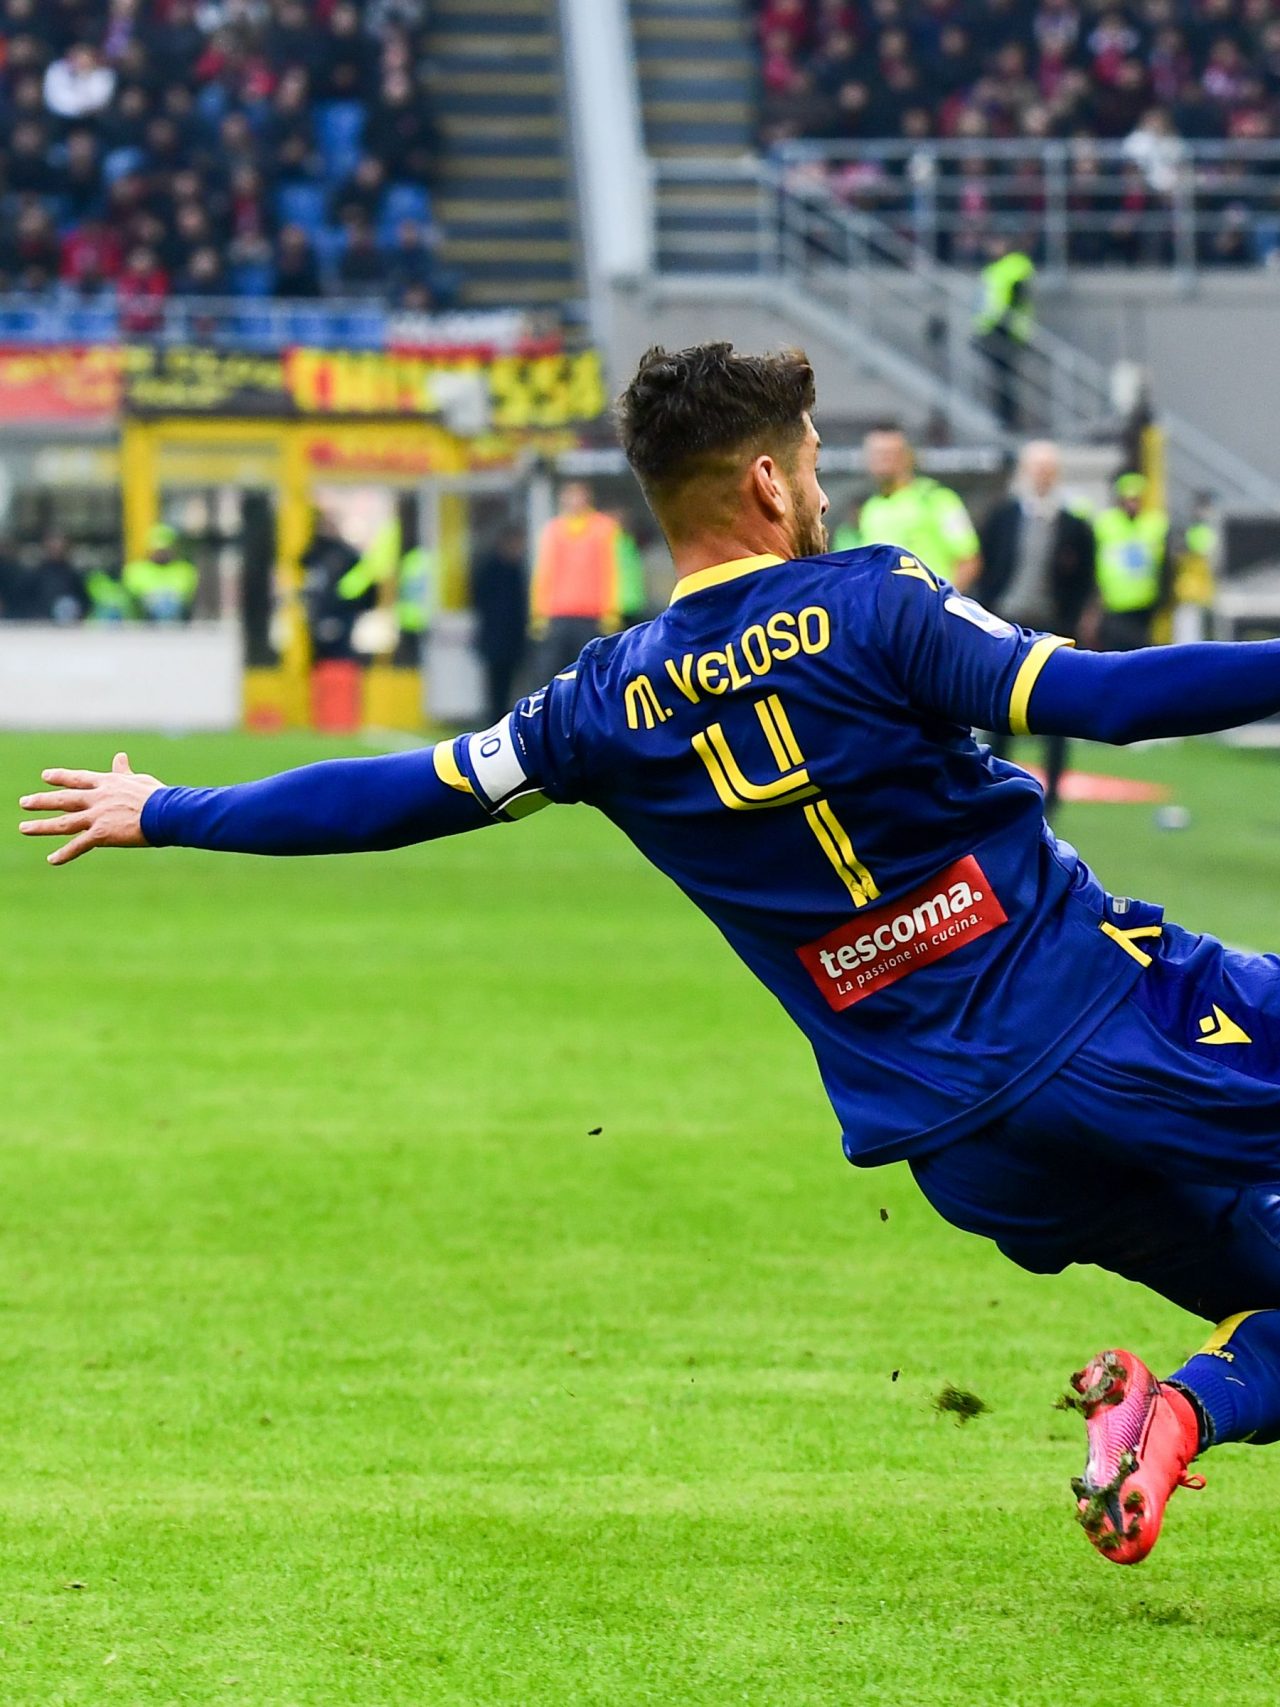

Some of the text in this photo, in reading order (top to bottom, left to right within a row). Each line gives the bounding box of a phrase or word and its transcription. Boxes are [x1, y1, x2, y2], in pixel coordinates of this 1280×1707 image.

[624, 674, 674, 730] M.
[664, 606, 830, 704] VELOSO
[691, 693, 881, 909] 4
[819, 881, 984, 979] tescoma.
[836, 914, 984, 996] La passione in cucina.
